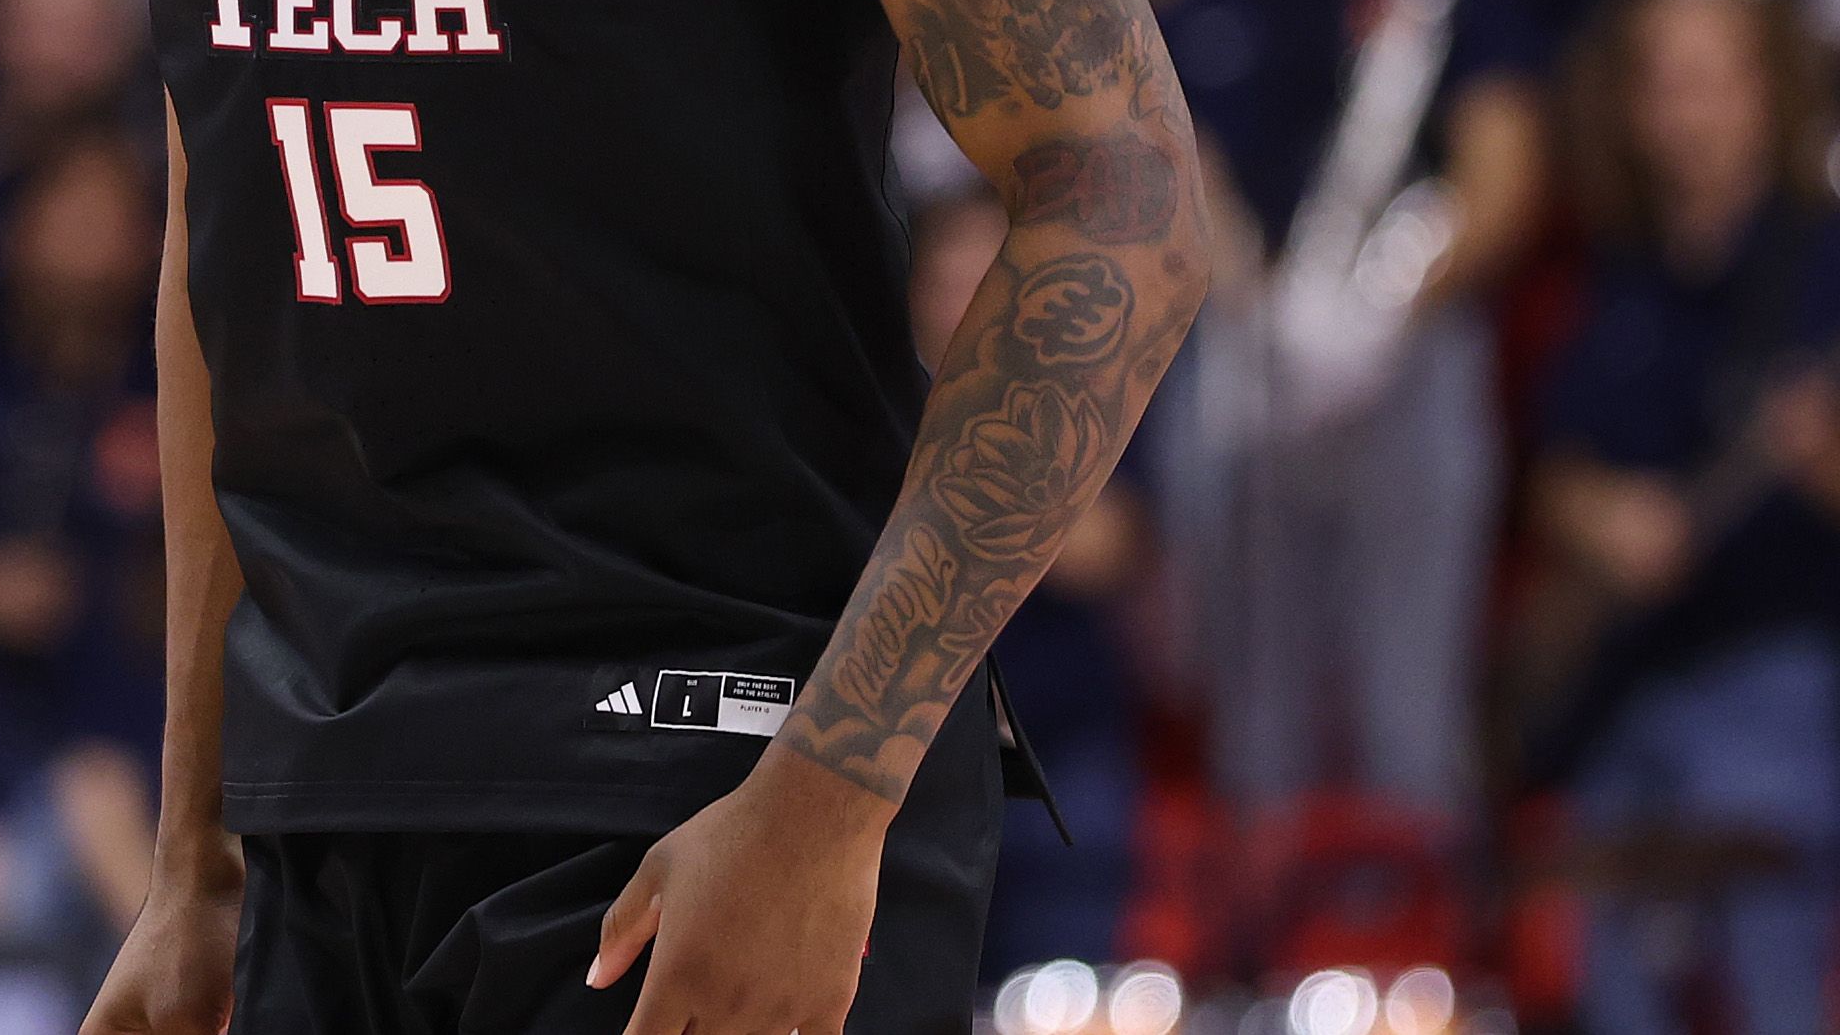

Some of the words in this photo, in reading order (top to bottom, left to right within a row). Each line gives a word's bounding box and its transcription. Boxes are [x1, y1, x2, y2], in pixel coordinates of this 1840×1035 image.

[266, 97, 452, 305] 15
[682, 695, 692, 717] L
[741, 705, 762, 713] PLAYER
